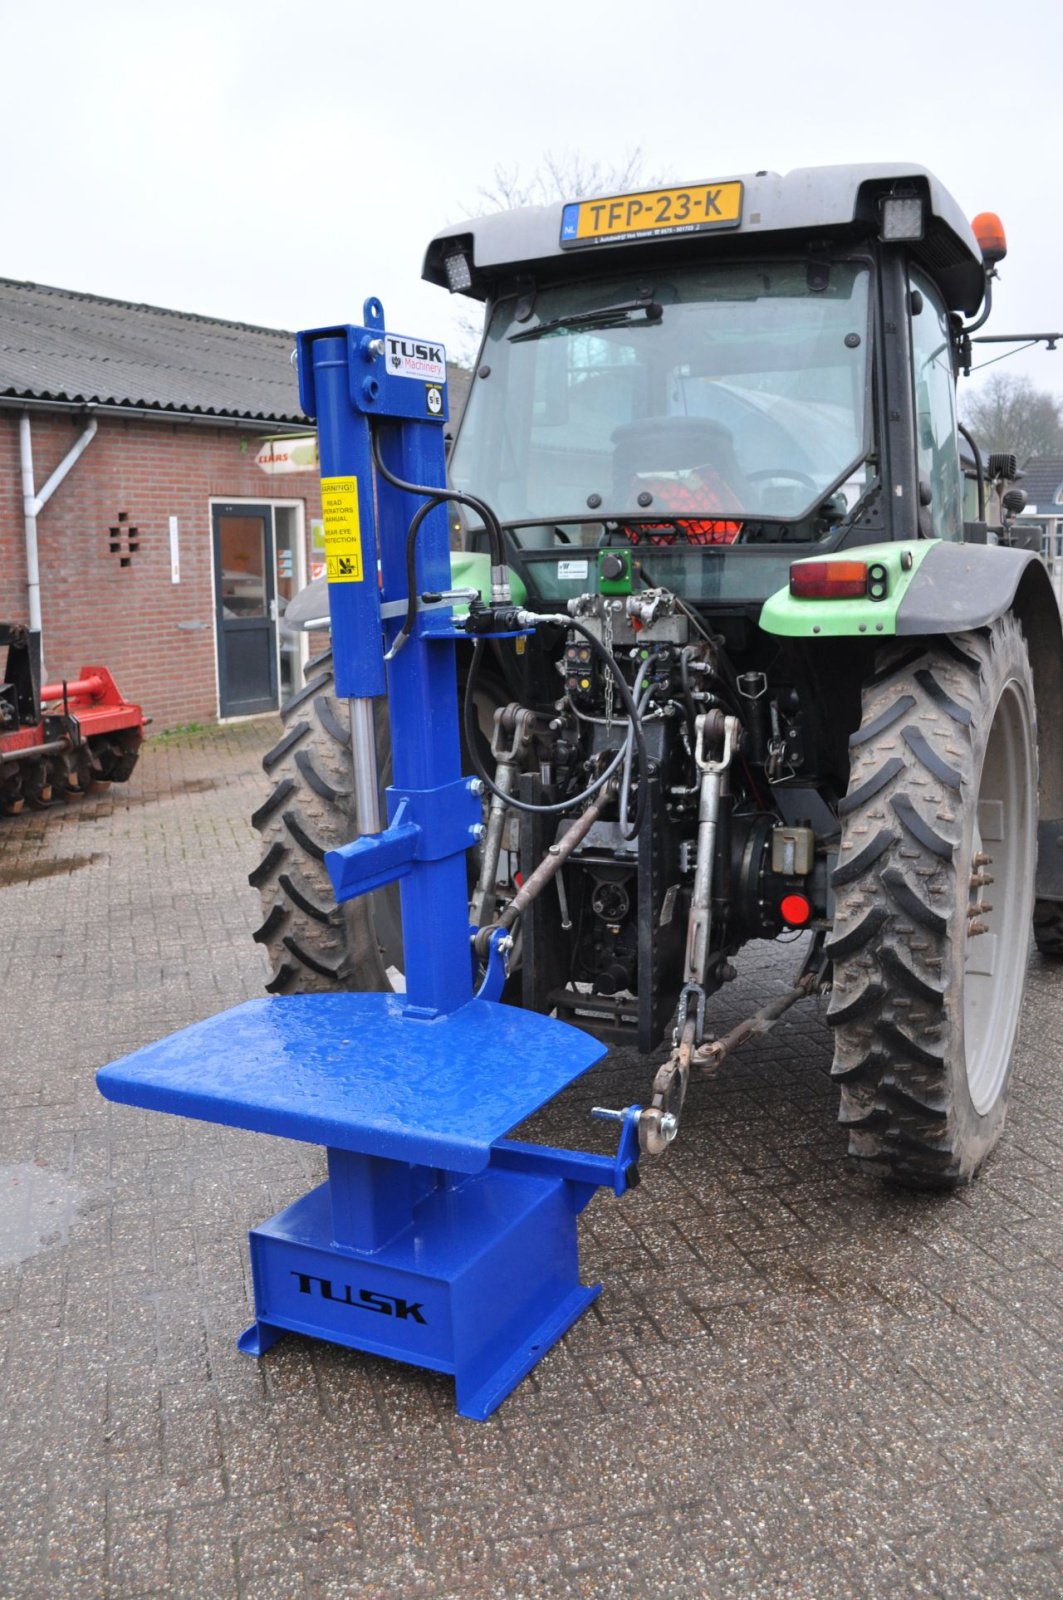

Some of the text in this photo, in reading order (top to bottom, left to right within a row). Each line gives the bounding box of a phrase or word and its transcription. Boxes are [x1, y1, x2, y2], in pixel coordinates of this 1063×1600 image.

[590, 190, 722, 230] TFP-23-K
[564, 226, 576, 234] NL
[387, 339, 442, 363] TUSK
[404, 358, 442, 375] Machinery
[290, 1271, 427, 1325] TUSK
